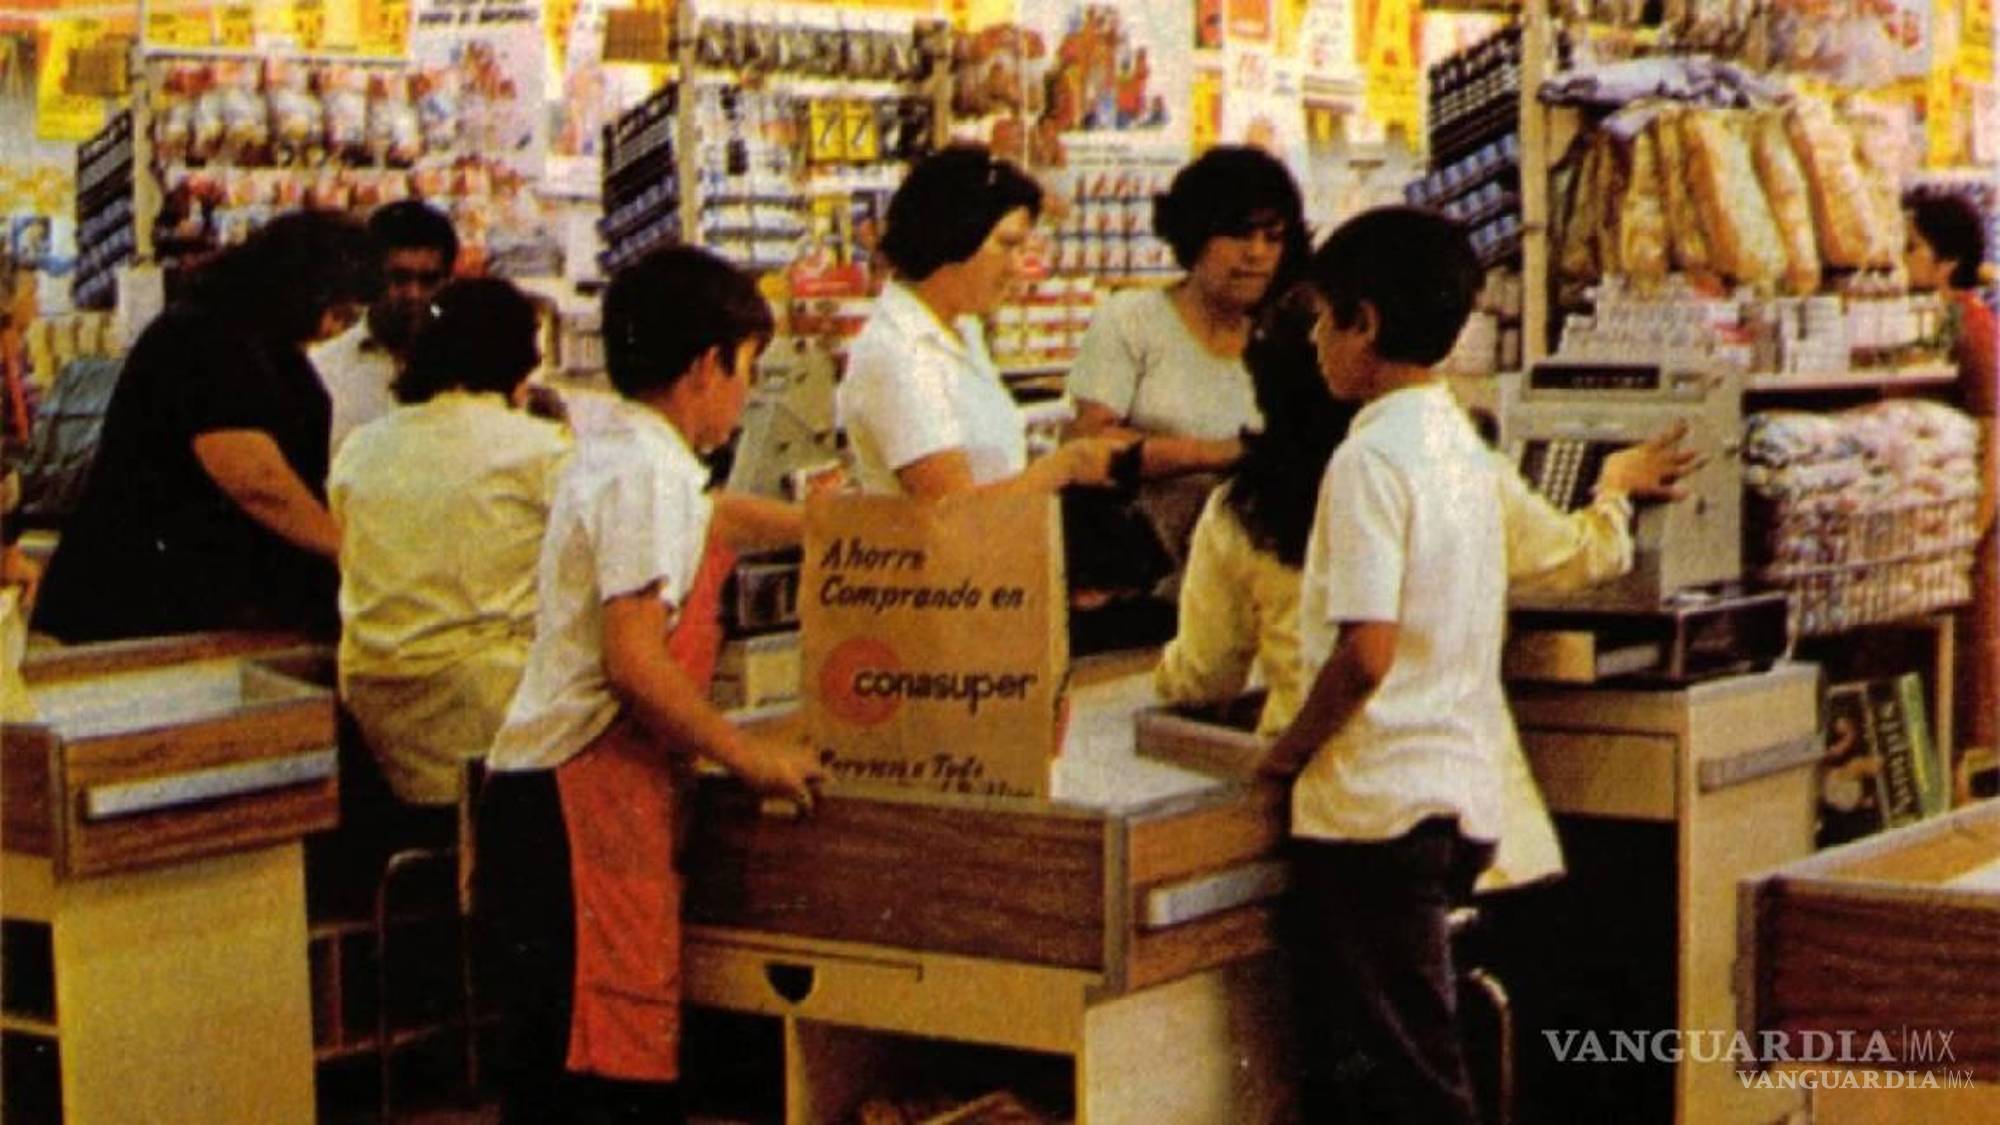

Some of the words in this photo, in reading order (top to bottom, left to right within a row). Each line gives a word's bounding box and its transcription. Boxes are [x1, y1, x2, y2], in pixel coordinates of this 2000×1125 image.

[820, 535, 926, 570] Ahorre
[819, 575, 982, 614] Comprando
[991, 585, 1025, 611] en
[855, 671, 1039, 716] conasuper
